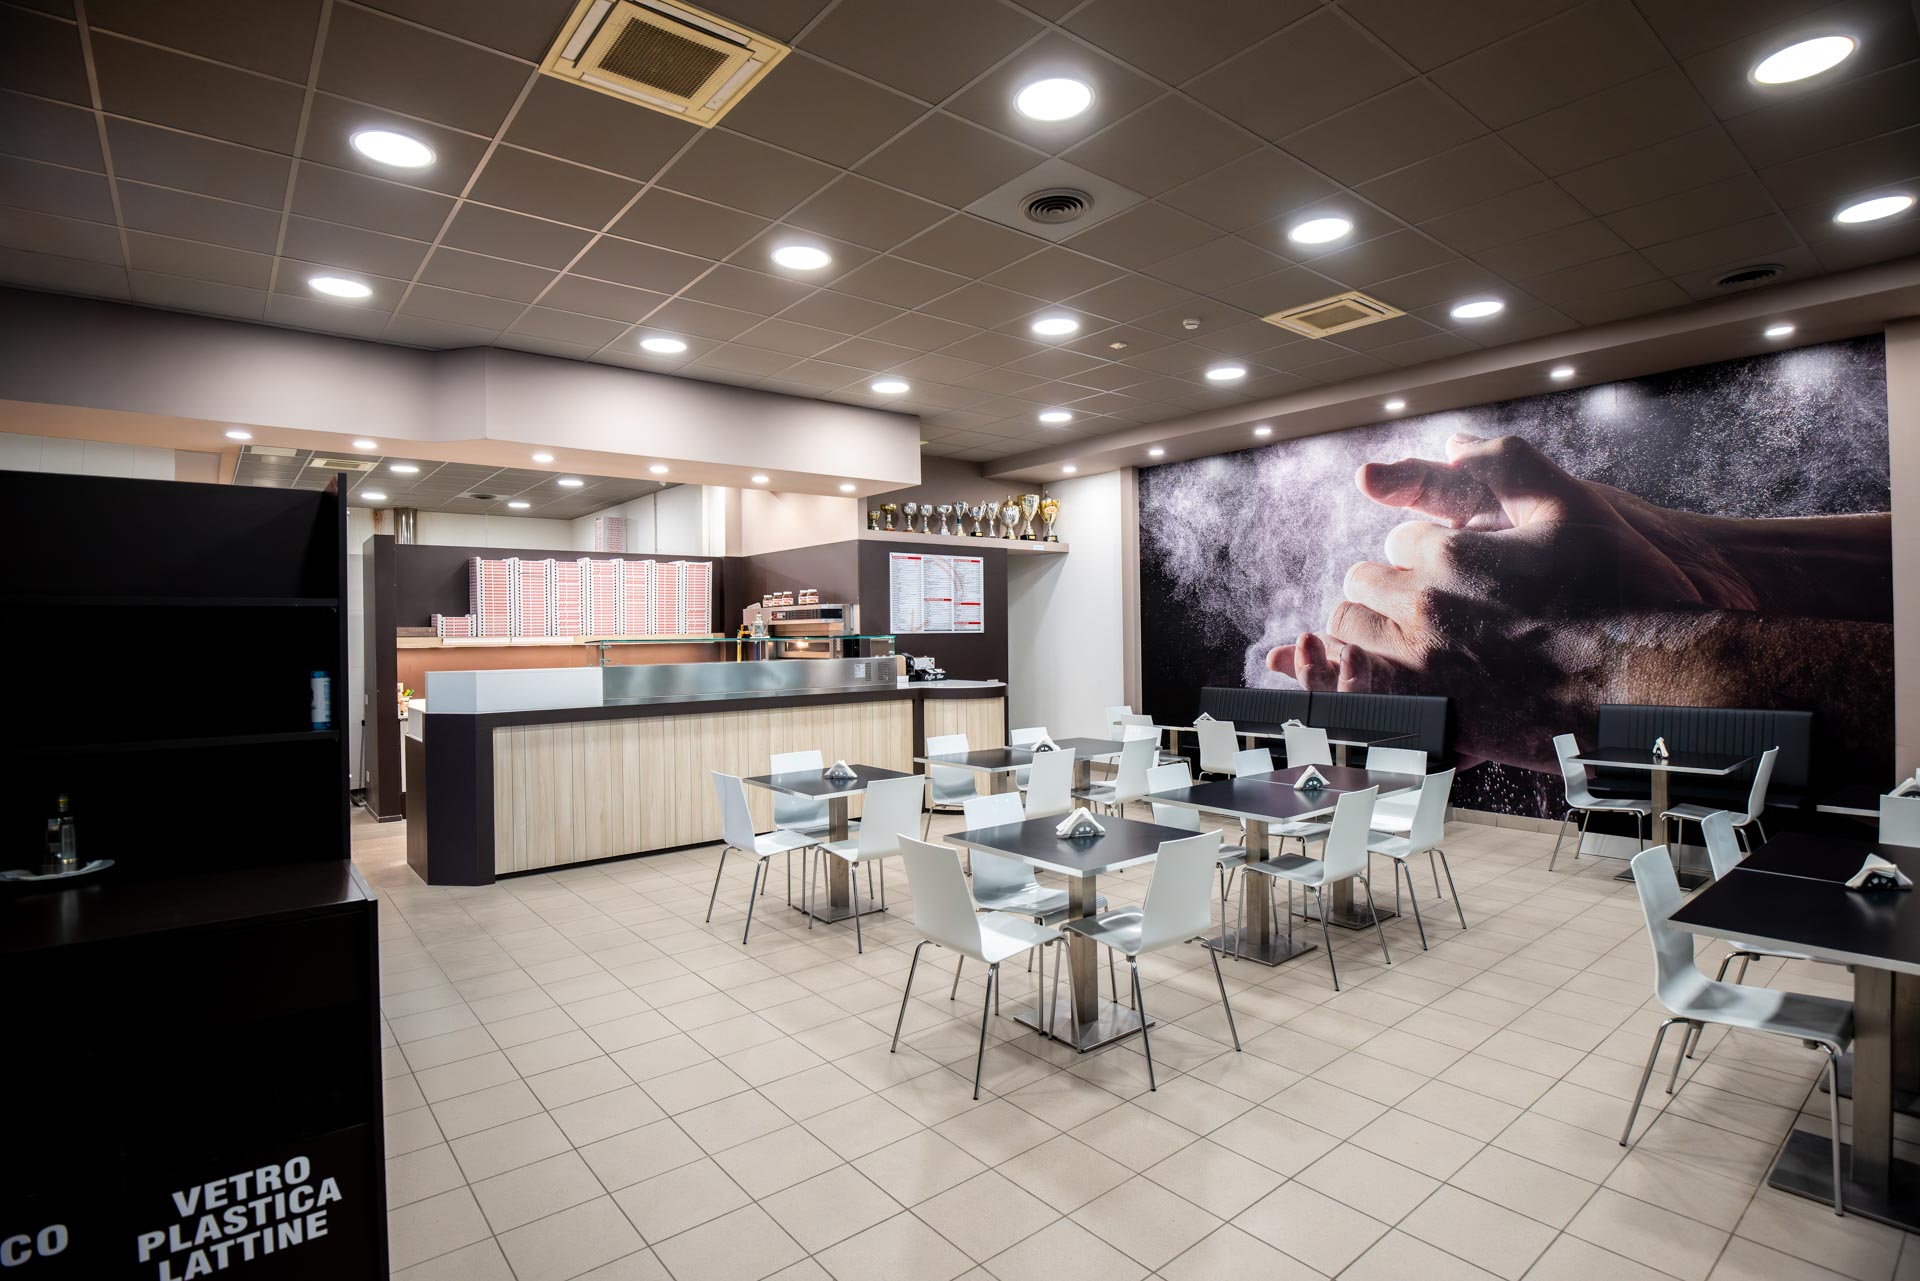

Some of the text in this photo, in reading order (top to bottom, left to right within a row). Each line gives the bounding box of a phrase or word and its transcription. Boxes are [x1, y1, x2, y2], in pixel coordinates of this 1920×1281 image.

[138, 1177, 343, 1262] PLASTICA
[172, 1156, 311, 1217] VETRO
[158, 1209, 329, 1281] LATTINE
